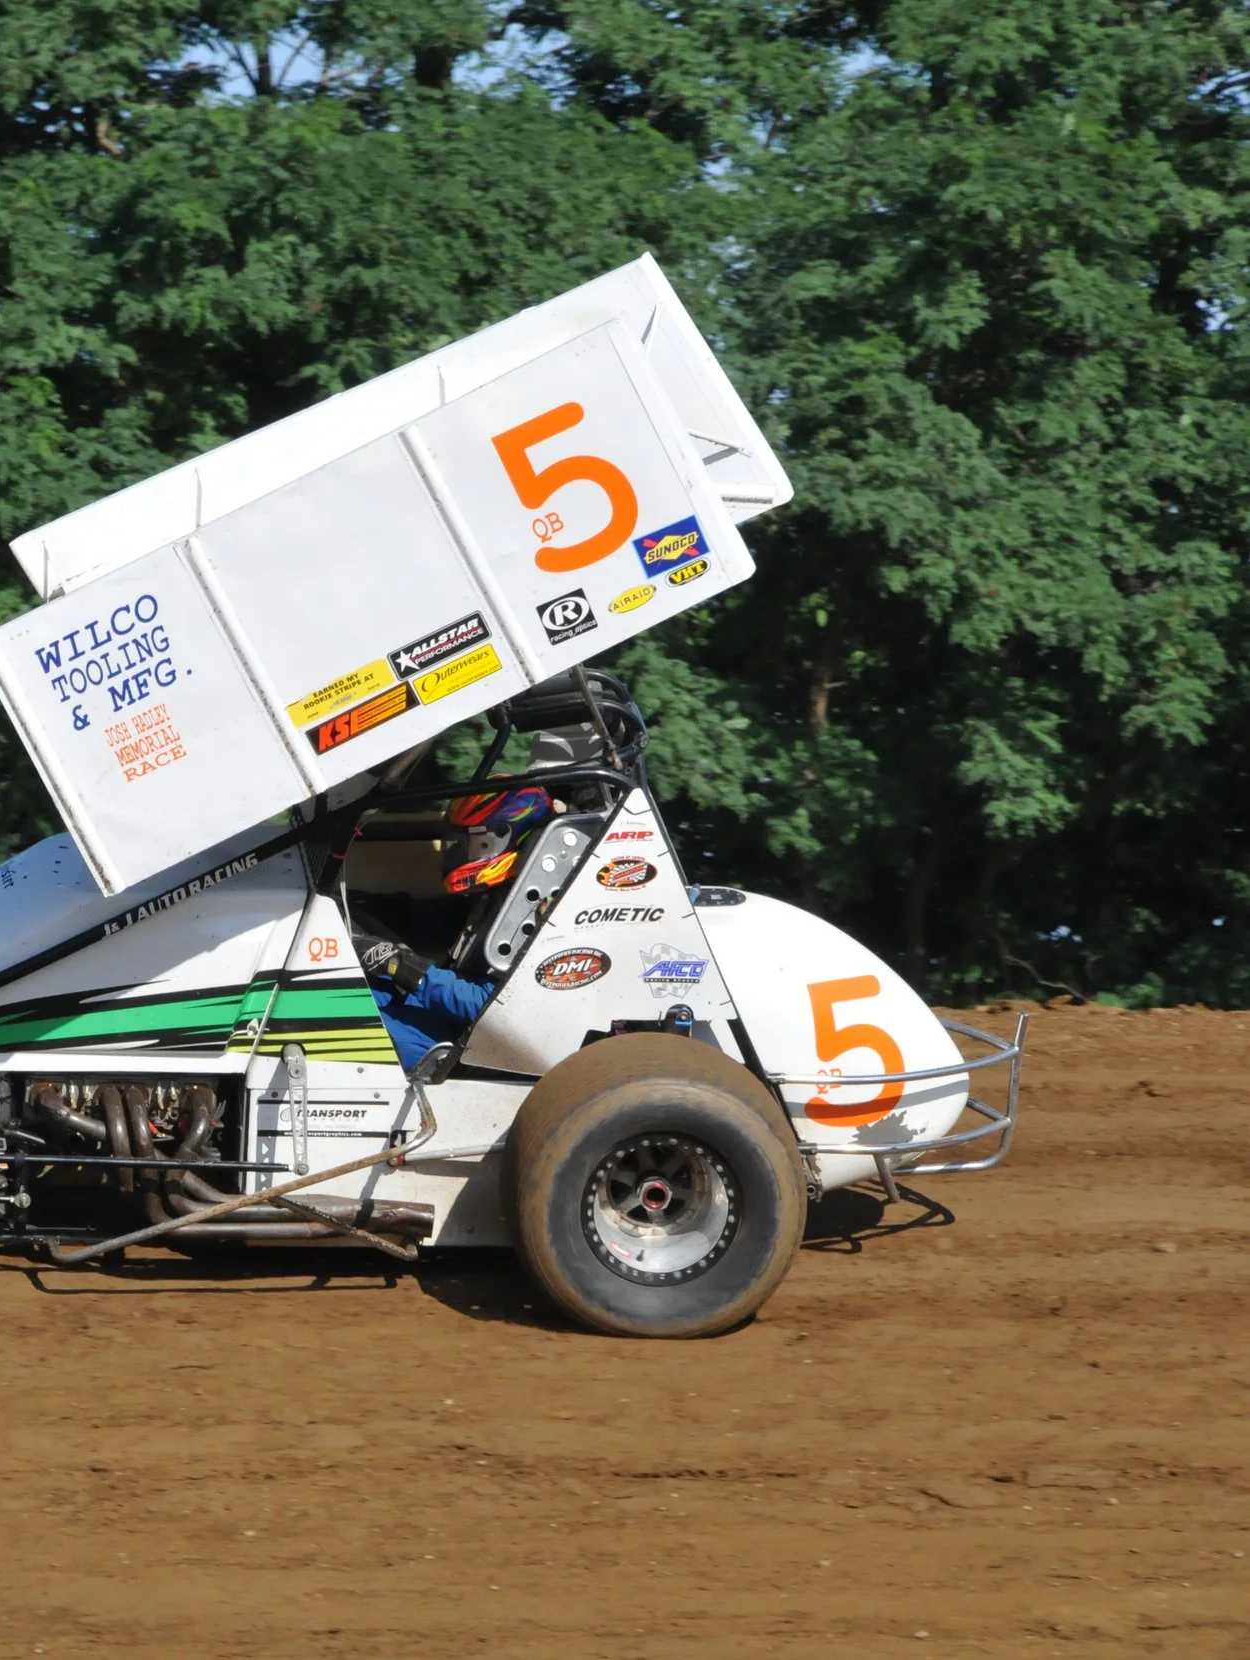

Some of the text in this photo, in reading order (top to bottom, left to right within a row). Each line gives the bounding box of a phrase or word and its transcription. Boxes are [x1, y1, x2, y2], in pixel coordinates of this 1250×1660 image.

[491, 401, 638, 573] 5
[532, 511, 564, 544] QB
[647, 532, 696, 563] SUNOCO
[669, 560, 706, 585] VHT
[553, 600, 579, 626] R
[613, 586, 651, 610] AIRAID
[34, 594, 159, 674] WILCO
[410, 617, 480, 658] ALLSTAR
[414, 627, 484, 665] PERFORMANCE
[550, 619, 597, 644] racing optics
[51, 625, 170, 703] TOOLING
[421, 650, 490, 692] Outerwears
[72, 657, 192, 731] & MFG.
[303, 692, 333, 710] ROOKIE
[334, 680, 363, 698] STRIPE
[363, 673, 375, 684] AT
[313, 672, 359, 698] EARNED MY
[104, 703, 171, 747] JOSH HADLEY
[318, 684, 407, 753] KSE
[114, 724, 181, 767] MEMORIAL
[123, 744, 187, 783] RACE
[605, 831, 654, 842] ARP
[187, 852, 259, 897] RACING
[574, 907, 665, 926] COMETIC
[308, 936, 339, 962] QB
[552, 958, 593, 976] DMI
[804, 974, 906, 1128] 5
